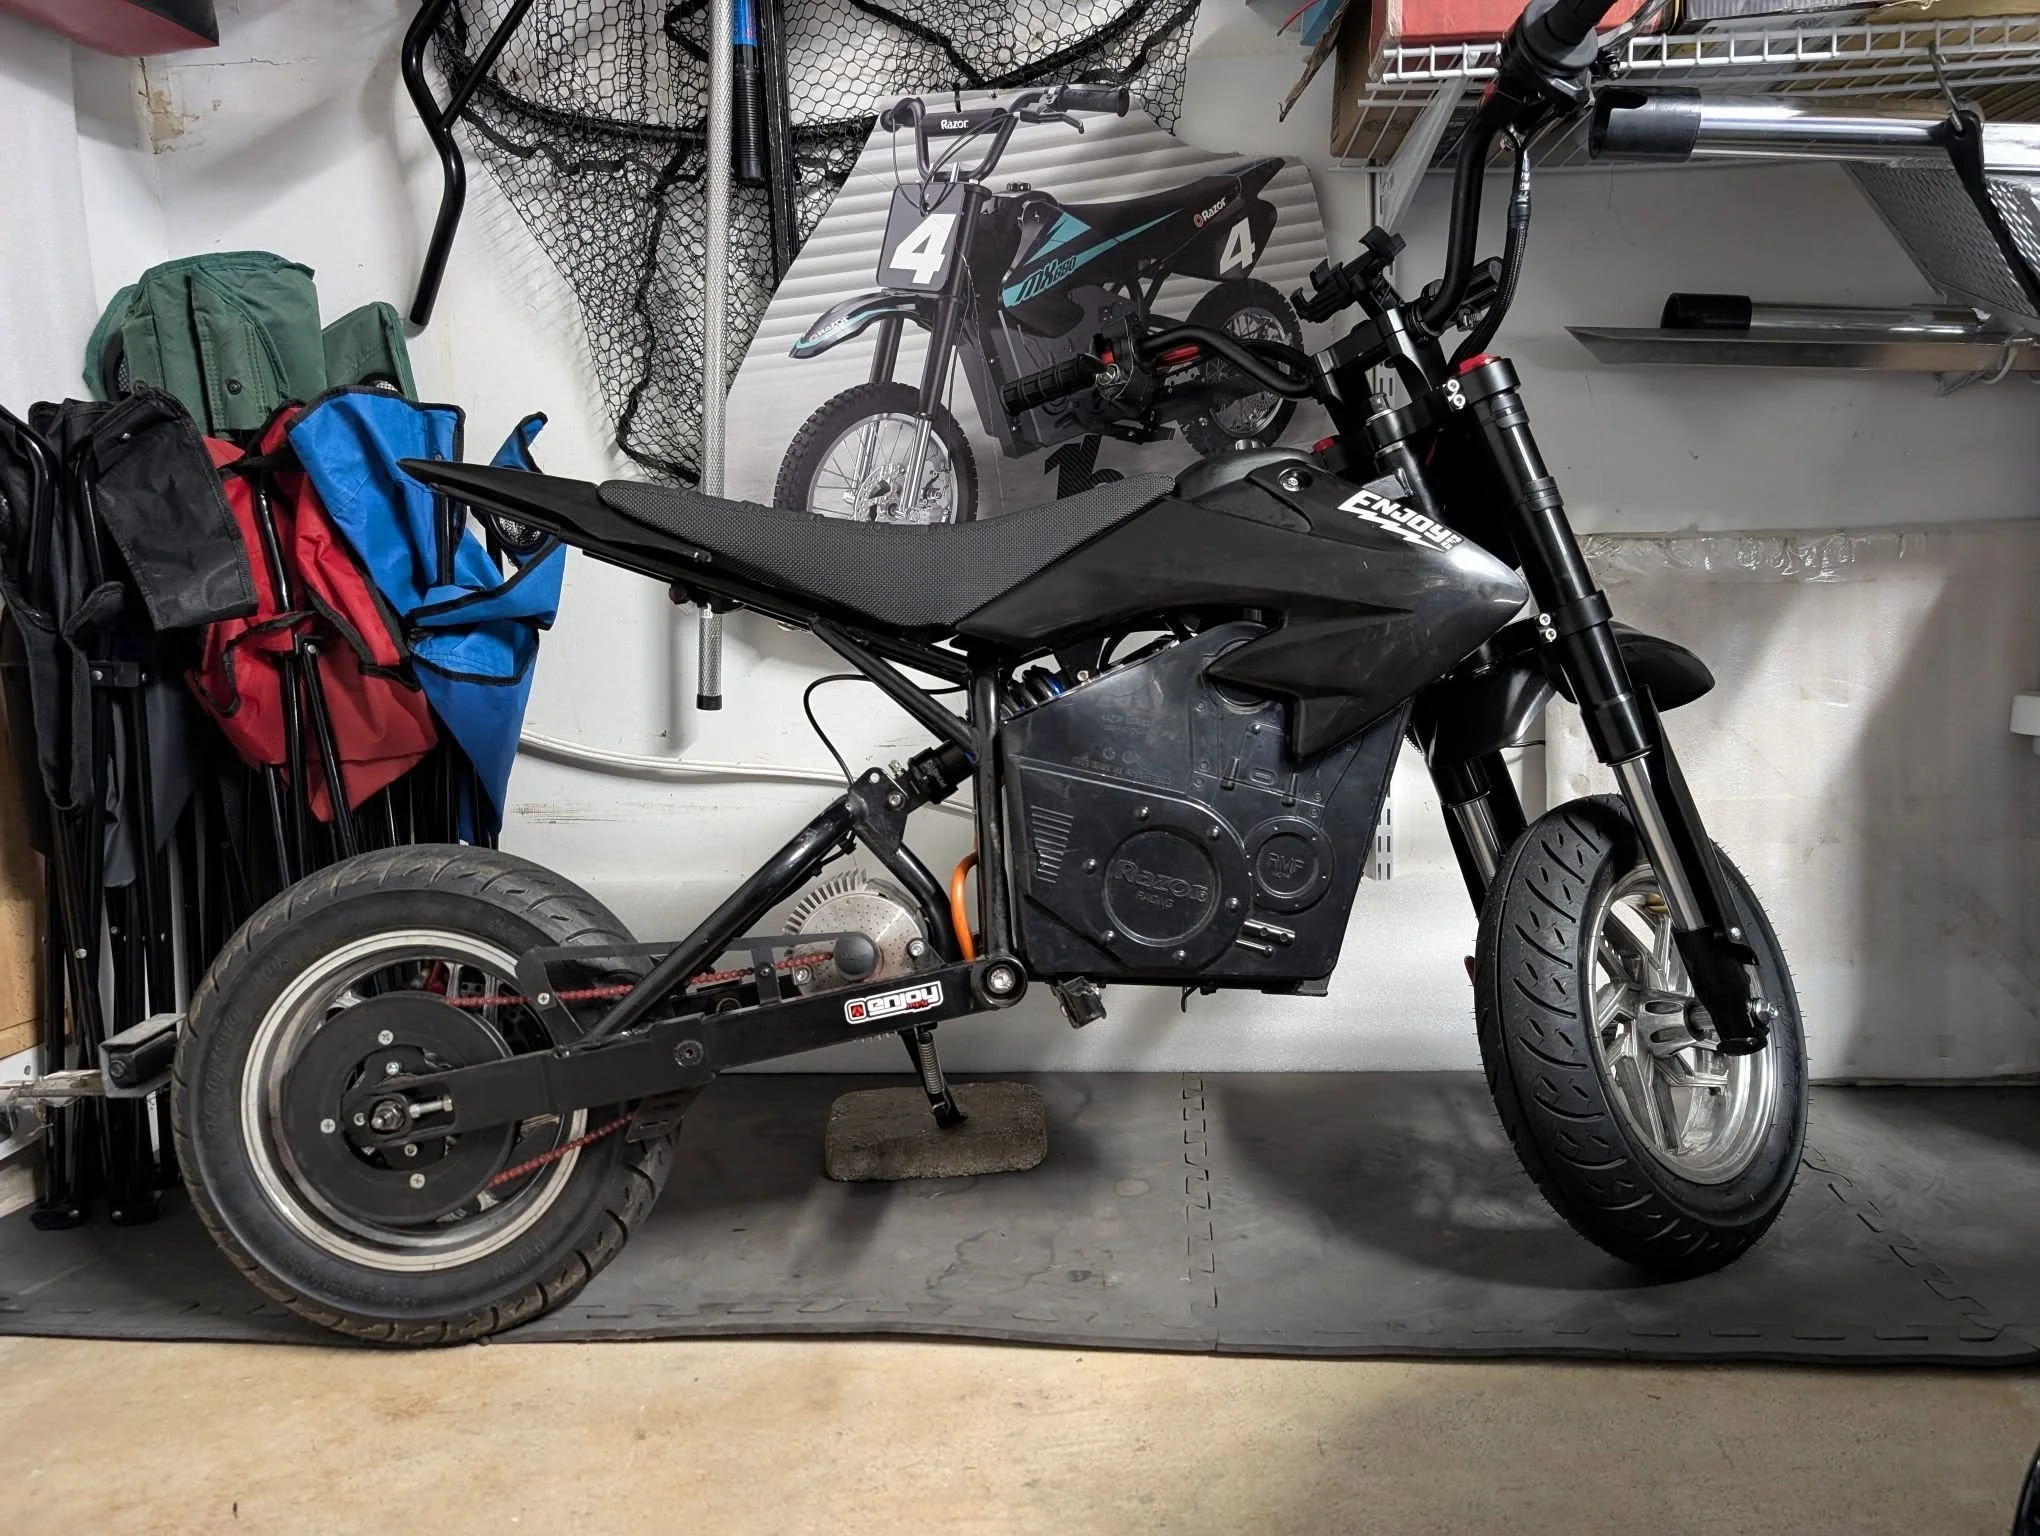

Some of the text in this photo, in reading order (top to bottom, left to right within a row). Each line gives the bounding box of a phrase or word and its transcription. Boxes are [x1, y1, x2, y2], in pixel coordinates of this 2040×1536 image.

[940, 119, 969, 130] Razor
[1201, 196, 1227, 222] Razor
[889, 213, 956, 284] 4
[1219, 216, 1256, 276] 4
[1337, 489, 1453, 543] ENJOY
[866, 985, 940, 1017] enjoy
